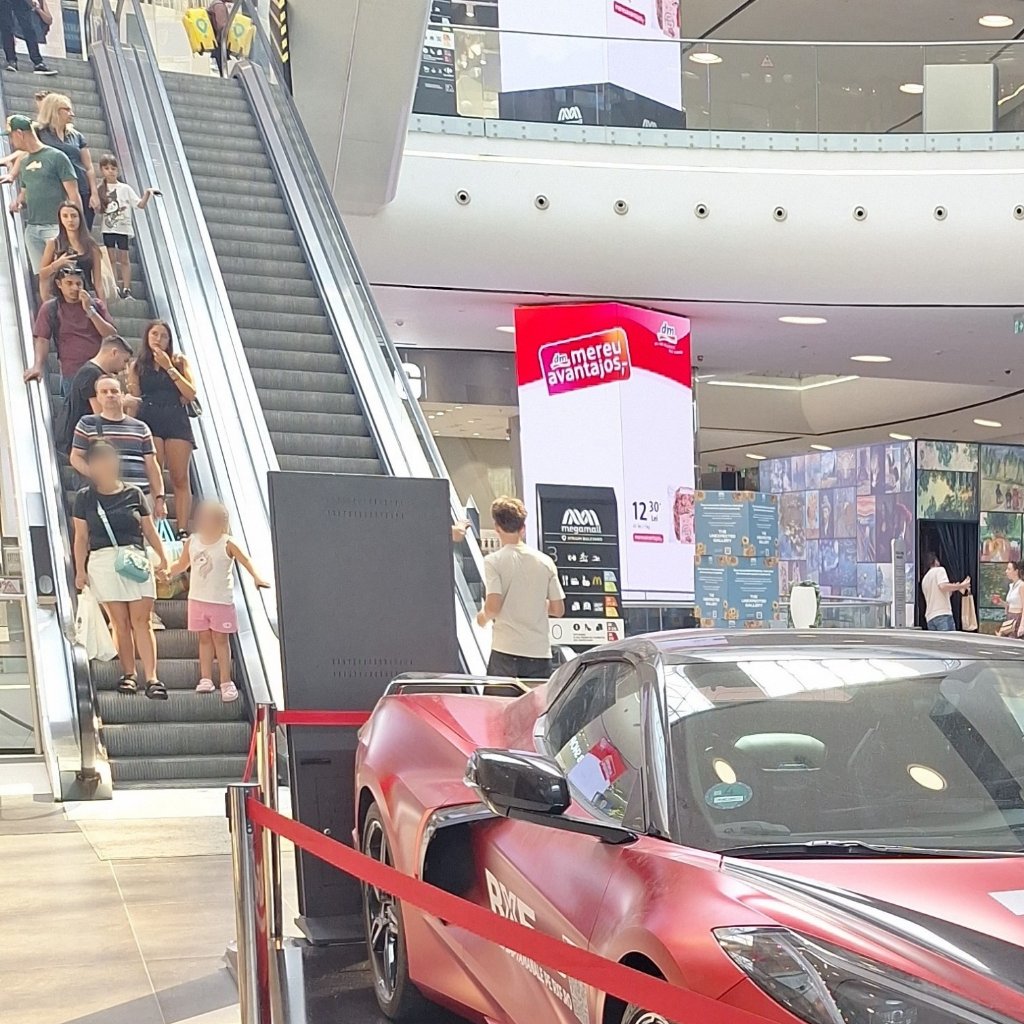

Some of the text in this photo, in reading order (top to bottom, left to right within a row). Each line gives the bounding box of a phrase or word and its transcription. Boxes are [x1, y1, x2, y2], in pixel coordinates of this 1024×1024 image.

[570, 340, 622, 365] mereu
[632, 501, 647, 521] 12
[561, 525, 602, 535] megamall
